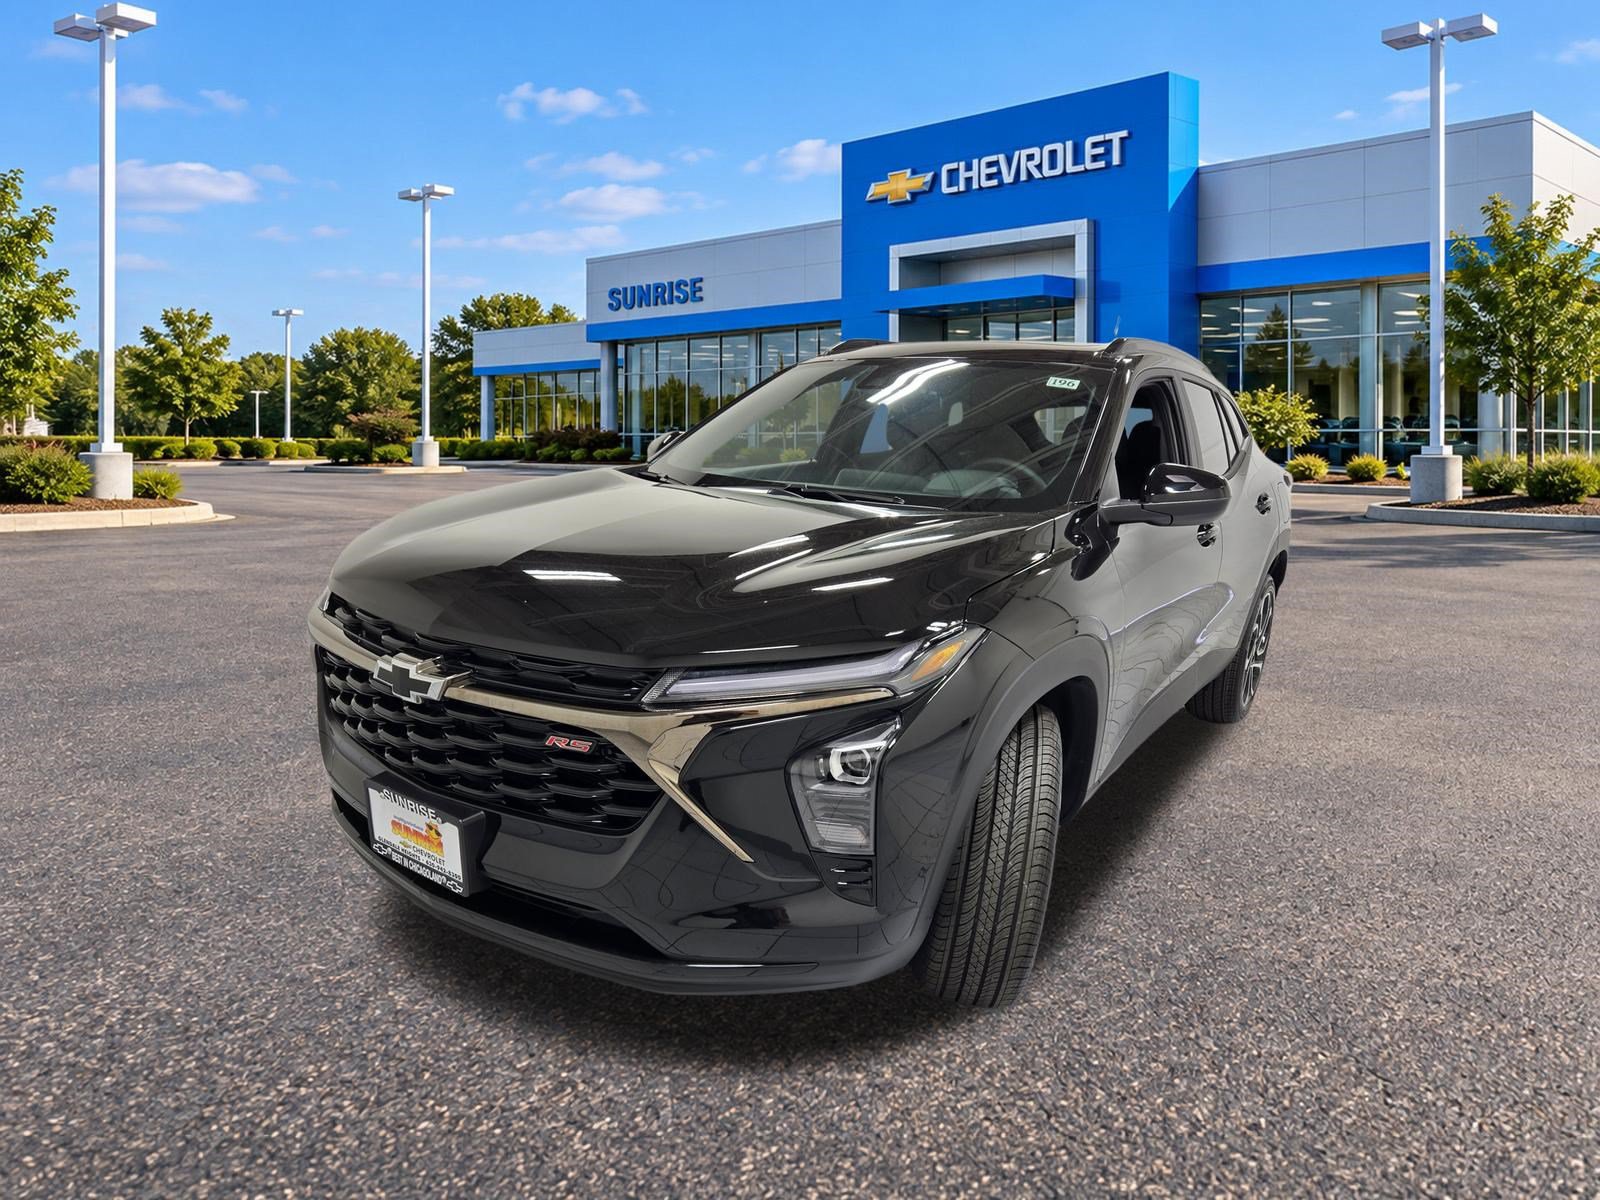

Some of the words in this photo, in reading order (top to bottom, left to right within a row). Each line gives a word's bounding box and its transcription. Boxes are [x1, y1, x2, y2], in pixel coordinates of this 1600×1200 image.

[940, 129, 1129, 194] CHEVROLET
[608, 277, 704, 311] SUNRISE
[1052, 379, 1075, 388] 196
[545, 735, 593, 752] RS
[382, 788, 437, 821] SUNRISE
[391, 851, 403, 867] BEST
[403, 857, 409, 869] IN
[409, 860, 442, 885] CHICAGOLAND
[401, 847, 421, 862] HEIGHTS
[412, 845, 446, 867] CHEVROLET
